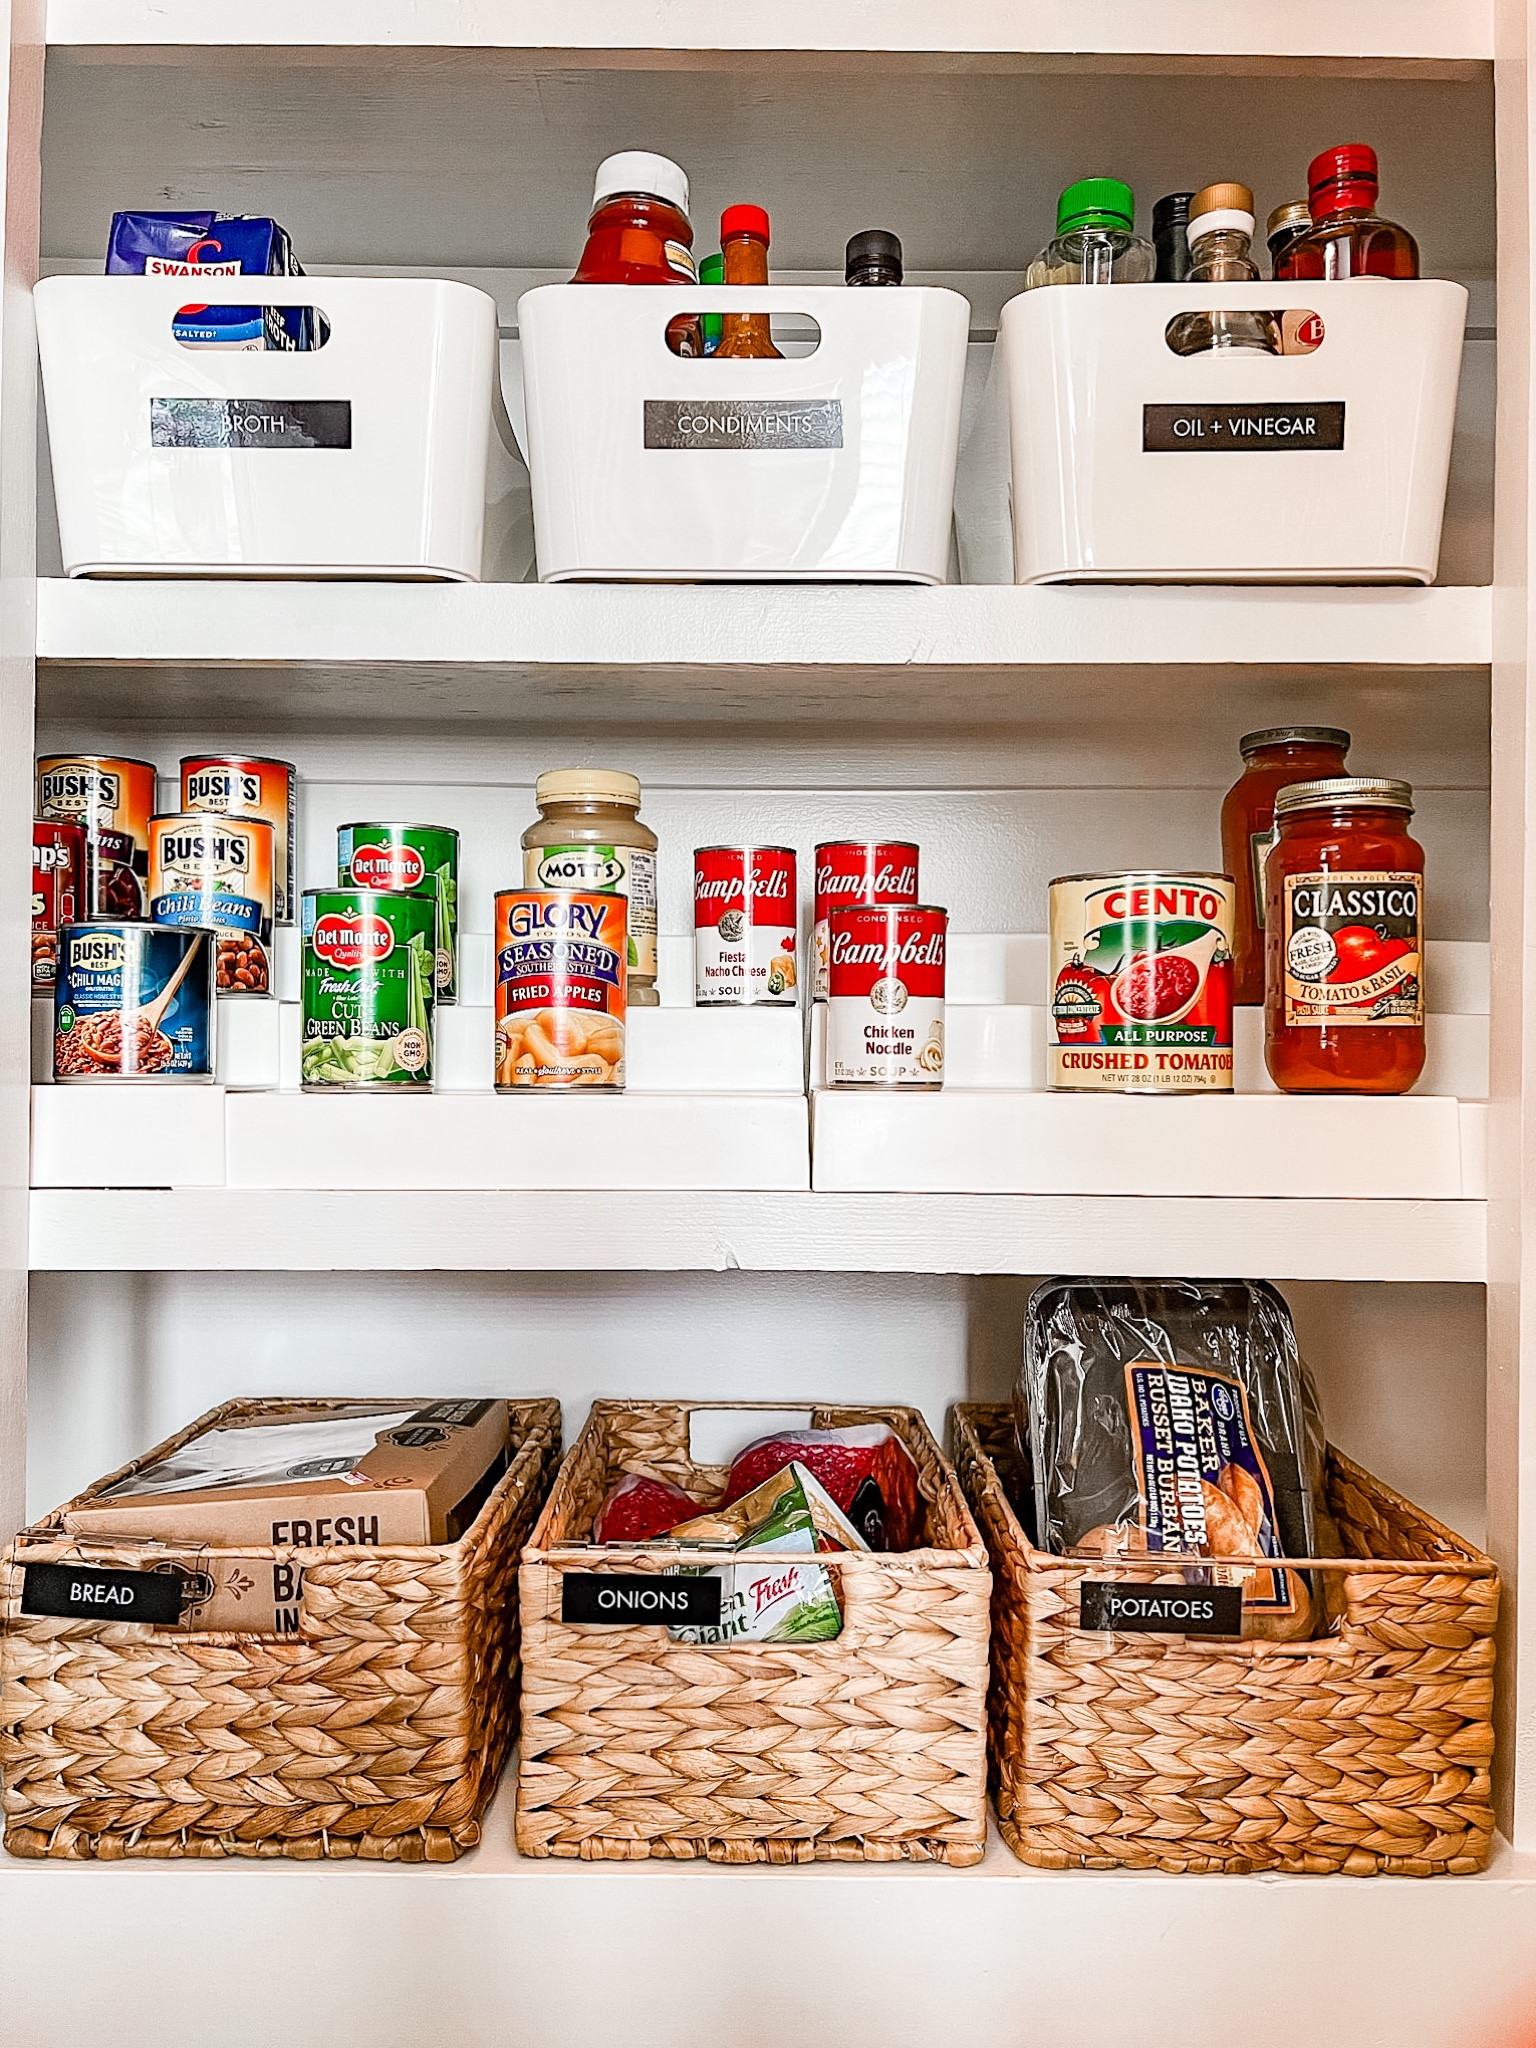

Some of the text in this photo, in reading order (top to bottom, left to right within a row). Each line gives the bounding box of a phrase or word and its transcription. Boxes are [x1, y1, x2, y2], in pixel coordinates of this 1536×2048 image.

[151, 262, 236, 276] SWANSON
[265, 309, 296, 351] ROTH
[221, 415, 285, 434] BROTH
[677, 415, 813, 434] CONDIMENTS
[1172, 417, 1316, 437] OIL + VINEGAR
[43, 775, 115, 802] BUSH'S
[188, 775, 258, 802] BUSH'S
[208, 798, 229, 806] BEST
[163, 837, 245, 865] BUSH'S
[355, 858, 419, 875] Del Monte
[694, 868, 788, 904] Campbell's
[816, 863, 917, 900] Campbell's
[156, 894, 253, 919] Chili Beans
[1103, 887, 1218, 920] CENTO
[1294, 889, 1417, 918] CLASSICO
[178, 915, 199, 925] Pinto
[508, 903, 608, 941] GLORY
[317, 931, 388, 946] Del Monte
[73, 941, 136, 963] BUSH'S
[503, 942, 613, 972] SEASONED
[831, 931, 944, 971] Campbell's
[1289, 940, 1334, 962] FRESH
[90, 961, 109, 969] BEST
[305, 967, 405, 979] MADE WITH
[567, 961, 596, 976] STYLE
[705, 965, 731, 978] Nacho
[72, 972, 127, 988] CHILI MAGI
[318, 976, 351, 996] Fresh
[1300, 964, 1406, 1001] TOMATO & BASIL
[512, 984, 602, 1003] FRIED APPLES
[331, 1001, 363, 1019] CUT
[1296, 1005, 1311, 1016] PASTA
[306, 1017, 400, 1037] GREEN BEANS
[863, 1025, 915, 1040] Chicken
[1113, 1030, 1209, 1043] ALL PURPOSE
[403, 1041, 422, 1049] NON
[403, 1049, 422, 1057] GMO
[865, 1042, 913, 1056] Noodle
[1061, 1052, 1233, 1071] CRUSHED TOMATOE
[1101, 1074, 1115, 1083] NET
[1118, 1074, 1129, 1082] WT
[1131, 1074, 1141, 1083] 28
[1142, 1074, 1152, 1083] OZ
[1161, 1074, 1171, 1083] LB
[1173, 1074, 1181, 1083] 12
[1191, 1378, 1219, 1473] BAKER
[1217, 1420, 1232, 1457] BRAND
[1147, 1373, 1182, 1553] RUSSET BURBAN
[1166, 1373, 1208, 1545] IDAHO POTATOES
[271, 1514, 380, 1546] FRESH
[69, 1582, 135, 1606] BREAD
[597, 1589, 689, 1610] ONIONS
[748, 1566, 801, 1614] Fresh
[1109, 1598, 1214, 1620] POTATOES
